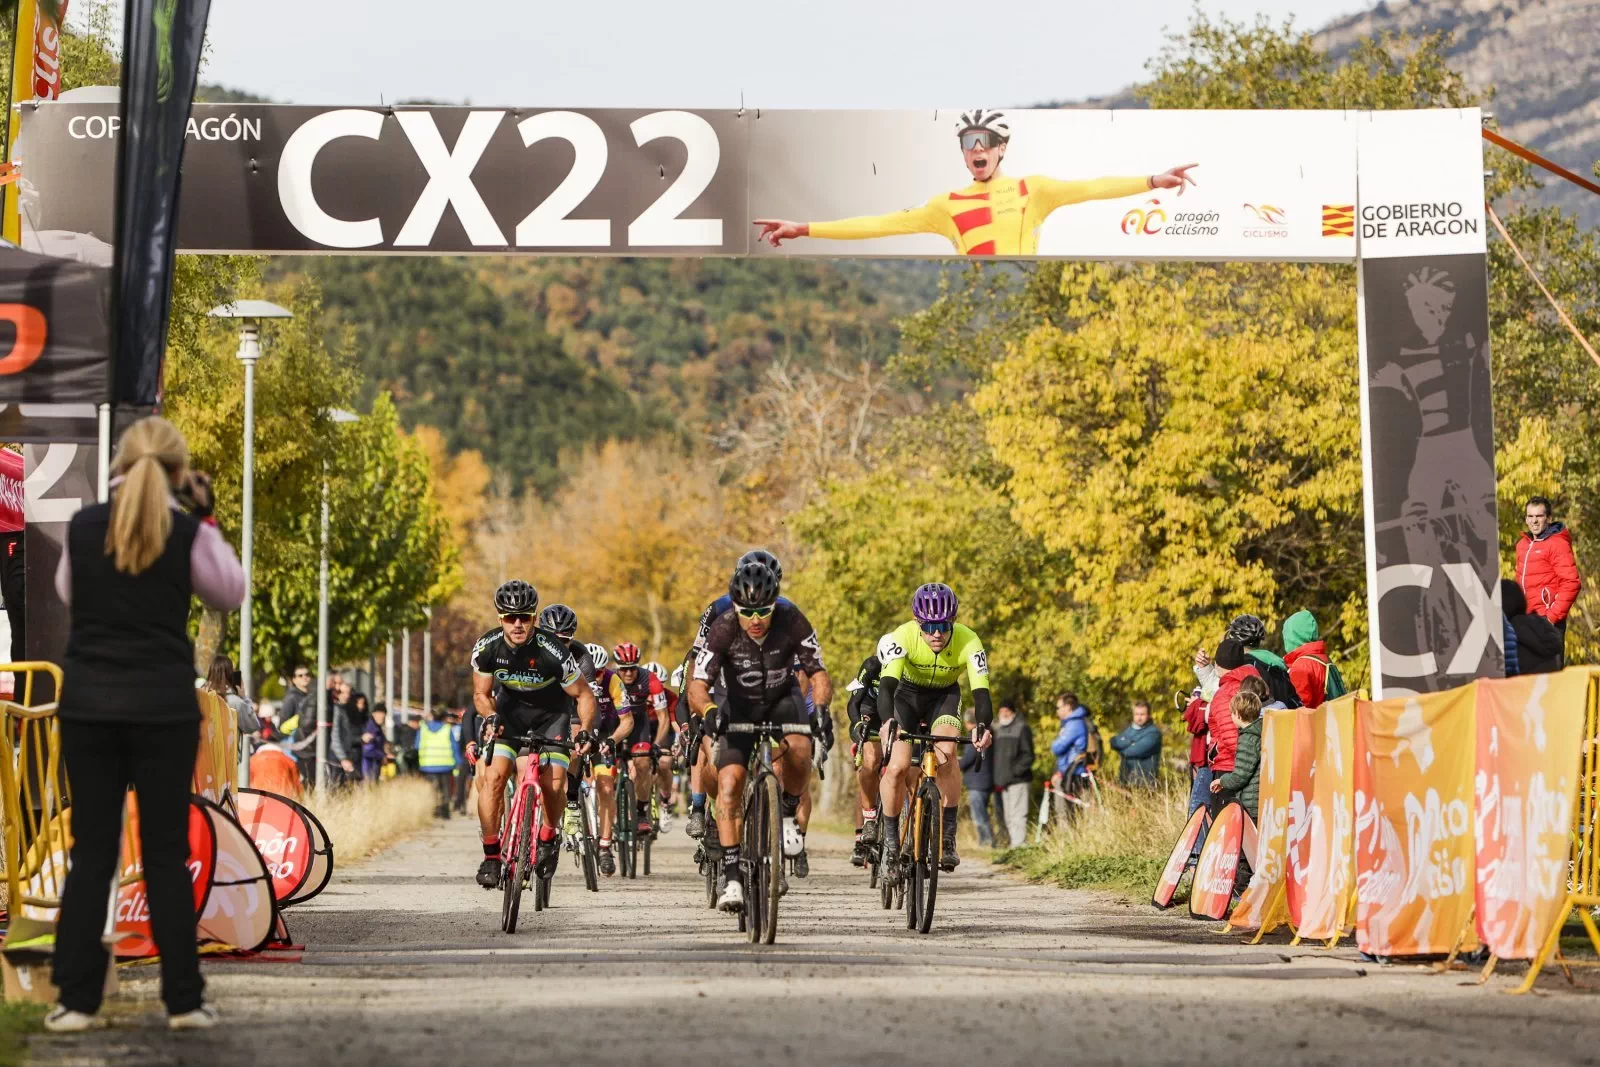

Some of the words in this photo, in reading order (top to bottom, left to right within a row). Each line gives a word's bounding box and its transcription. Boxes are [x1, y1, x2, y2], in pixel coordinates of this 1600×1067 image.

[277, 108, 723, 249] CX22
[1174, 210, 1220, 225] aragón
[1362, 202, 1463, 221] GOBIERNO
[1165, 223, 1219, 236] ciclismo
[1242, 229, 1289, 239] CICLISMO
[1362, 223, 1388, 239] DE
[1395, 218, 1478, 238] ARAGON
